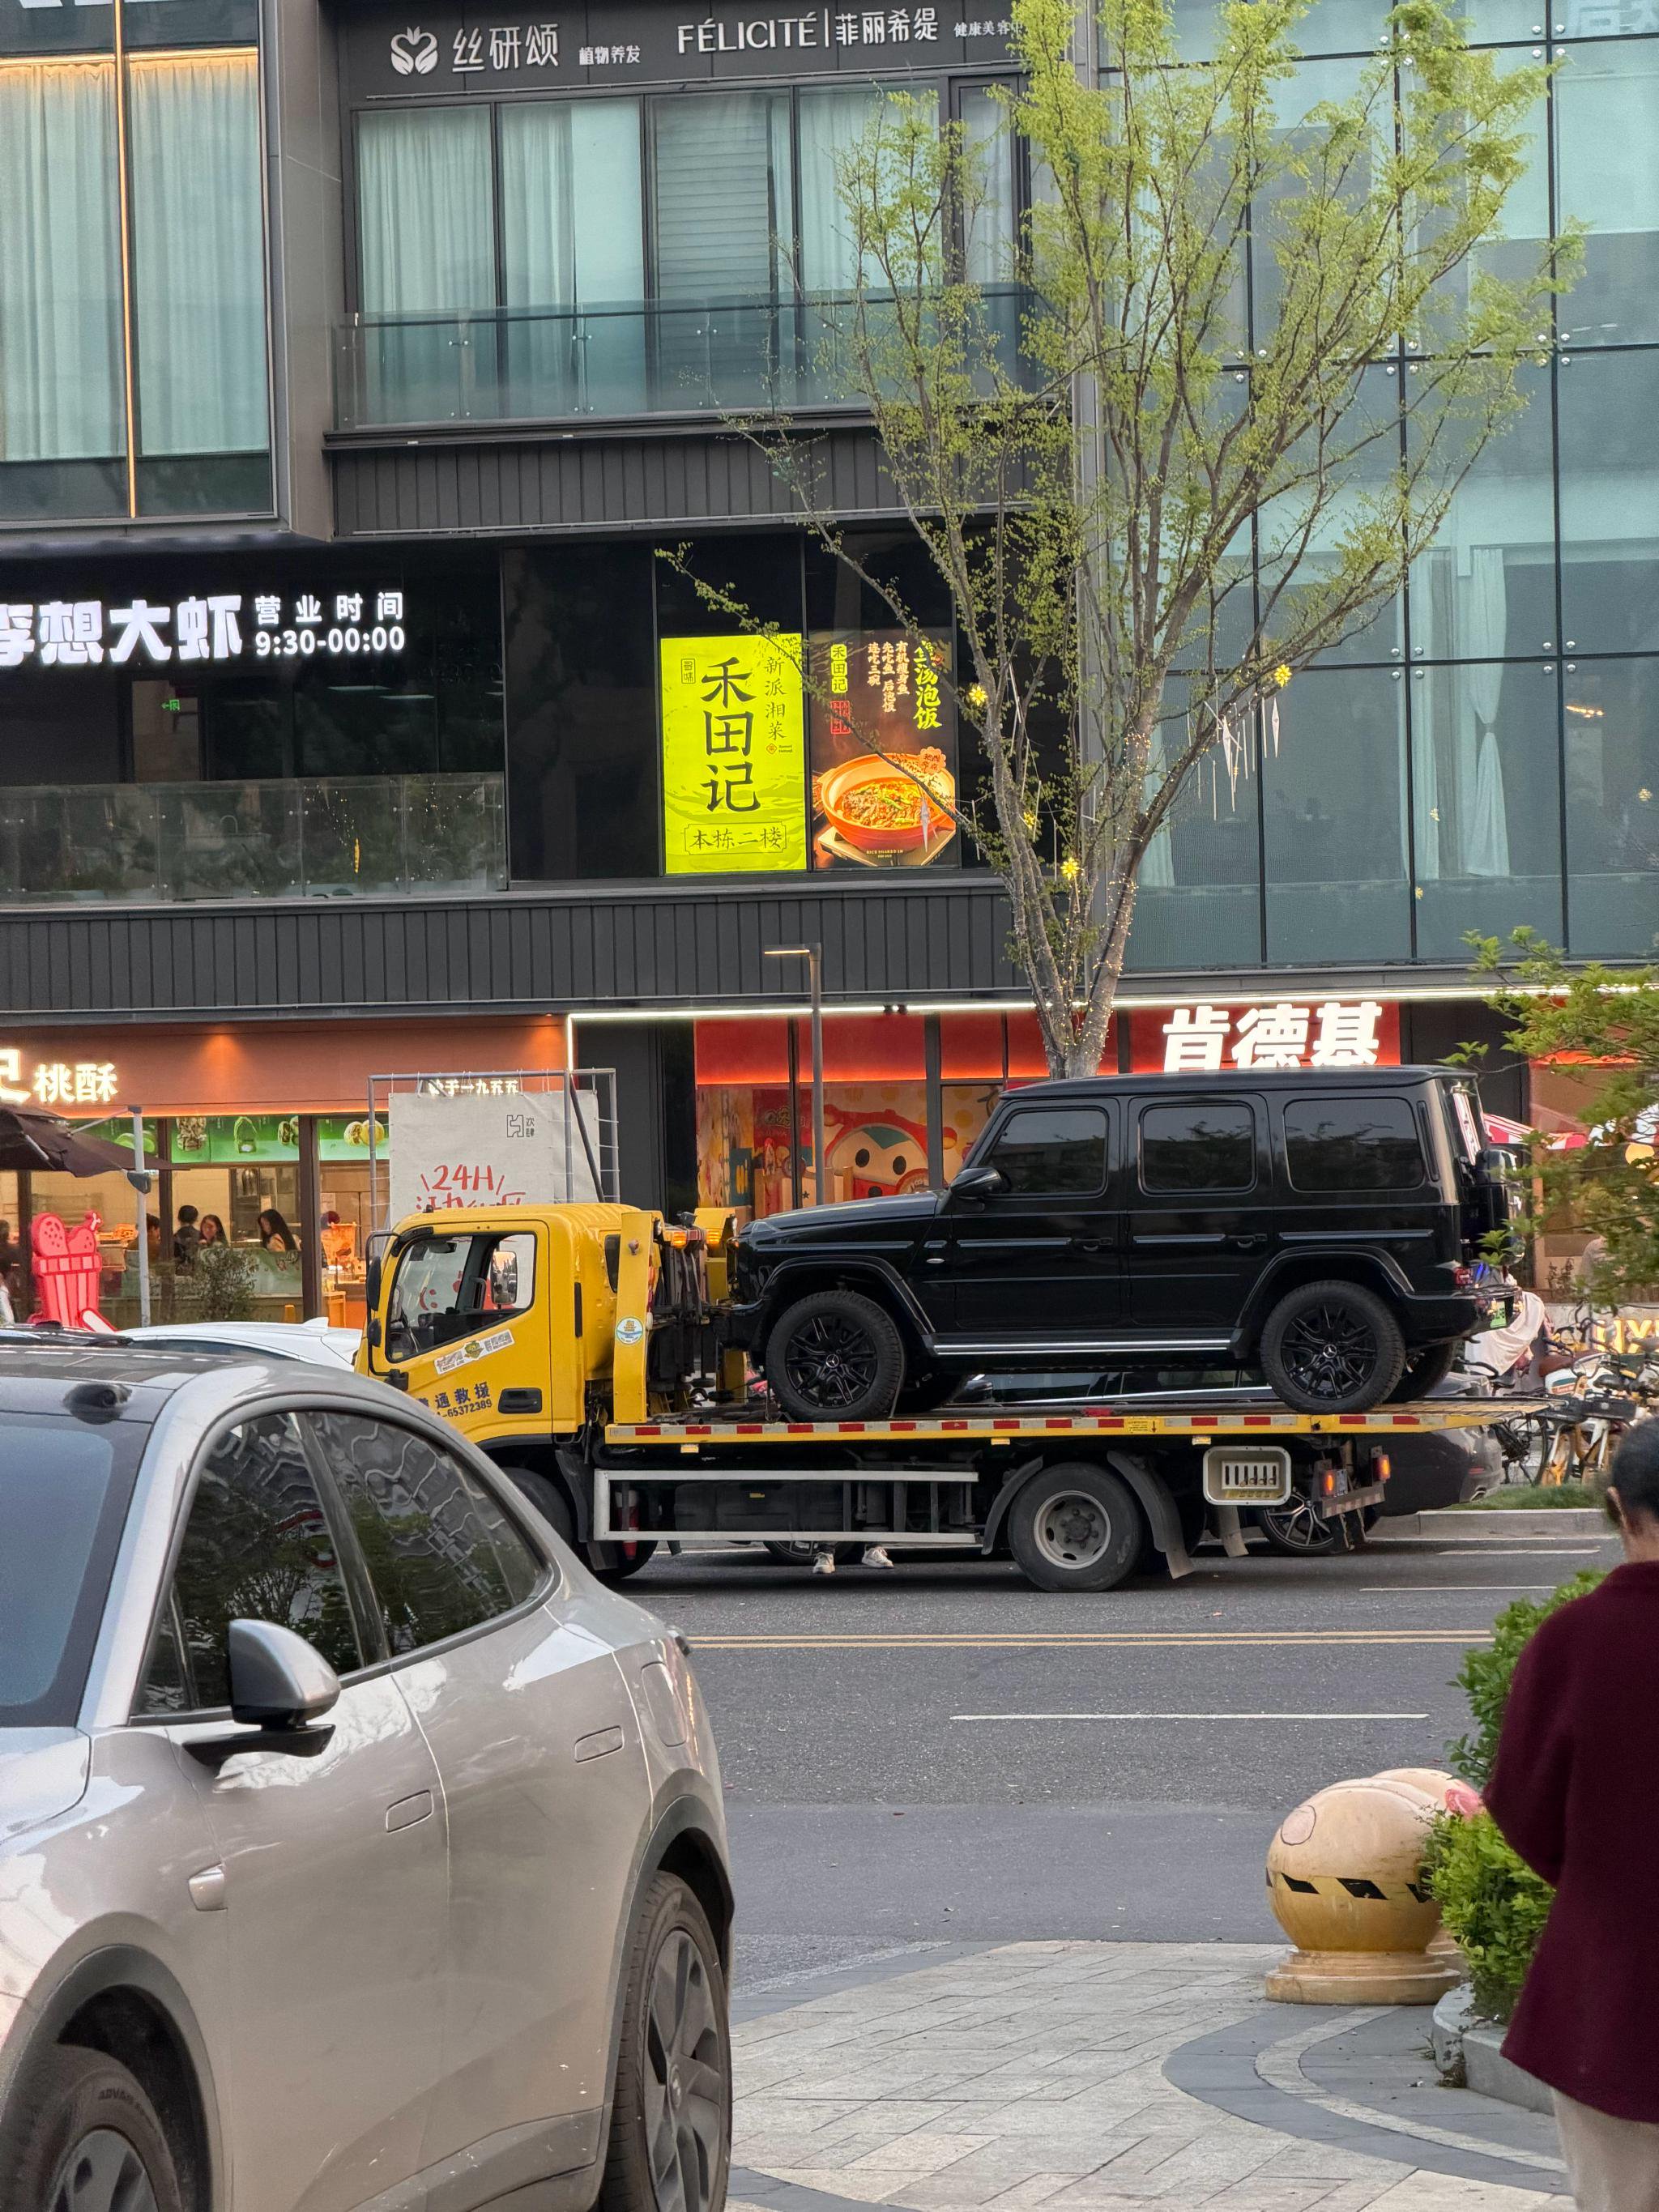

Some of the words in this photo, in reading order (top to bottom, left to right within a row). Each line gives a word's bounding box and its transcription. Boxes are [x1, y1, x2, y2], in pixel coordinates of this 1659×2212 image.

[452, 23, 559, 72] 丝研颂
[677, 11, 817, 54] FÉLICITÉ
[835, 7, 939, 46] 菲丽希缇
[578, 45, 641, 66] 植物养发
[254, 592, 403, 624] 营业时间
[255, 626, 405, 656] 9:30-00:00
[832, 646, 847, 692] 禾田记
[764, 656, 788, 741] 新派湘菜
[700, 657, 761, 812] 禾田记
[689, 826, 783, 851] 本栋二楼
[1162, 1001, 1383, 1072] 肯德基
[433, 1164, 493, 1191] 24H
